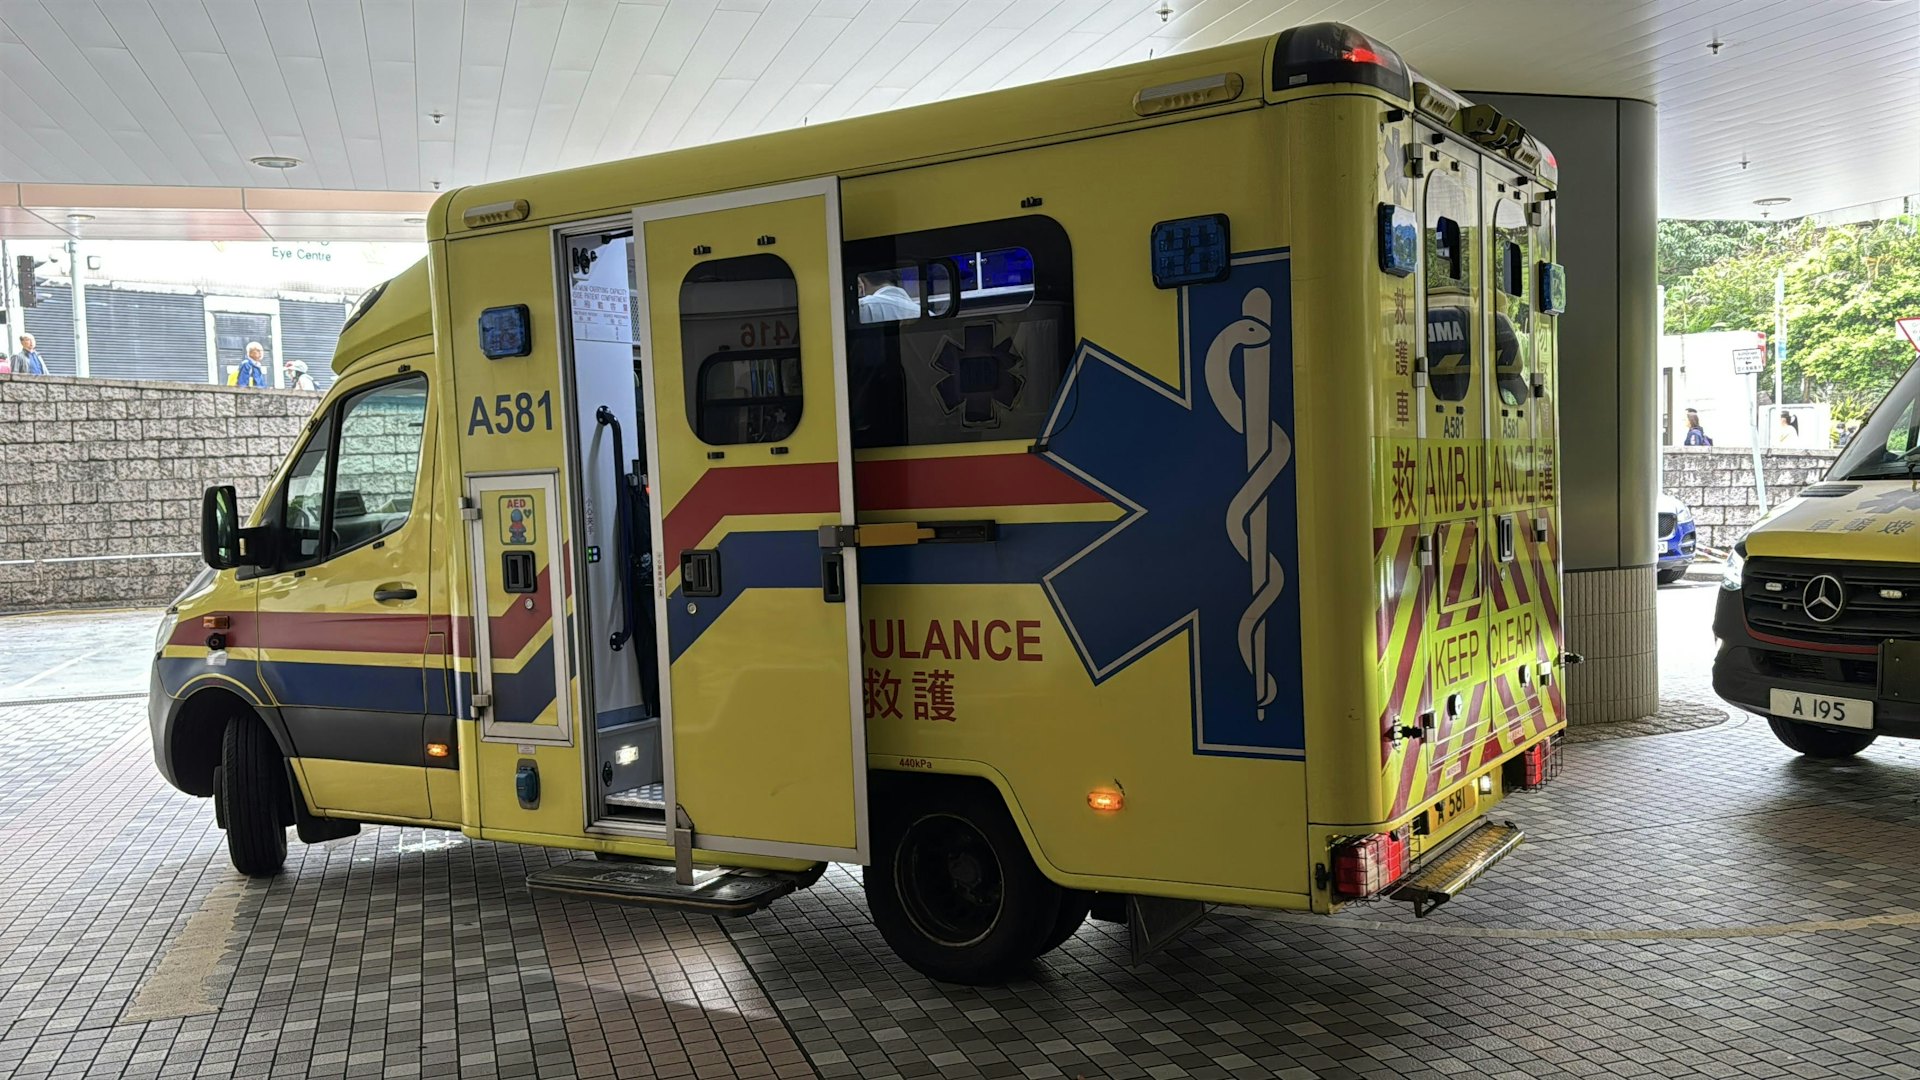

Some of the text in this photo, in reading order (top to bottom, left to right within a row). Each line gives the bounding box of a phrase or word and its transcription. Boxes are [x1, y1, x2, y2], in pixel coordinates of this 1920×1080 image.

[272, 246, 332, 262] Eye Centre
[1394, 287, 1409, 427] 救護車
[467, 390, 552, 436] A581
[1443, 415, 1465, 438] A581
[1503, 417, 1519, 439] A581
[1424, 445, 1535, 517] AMBULANCE
[506, 499, 526, 508] AED
[861, 619, 1044, 662] ULANCE
[1435, 612, 1534, 690] KEEP CLEAR
[1793, 697, 1846, 722] A 195
[899, 758, 933, 769] 440kPa
[1449, 786, 1466, 817] 581
